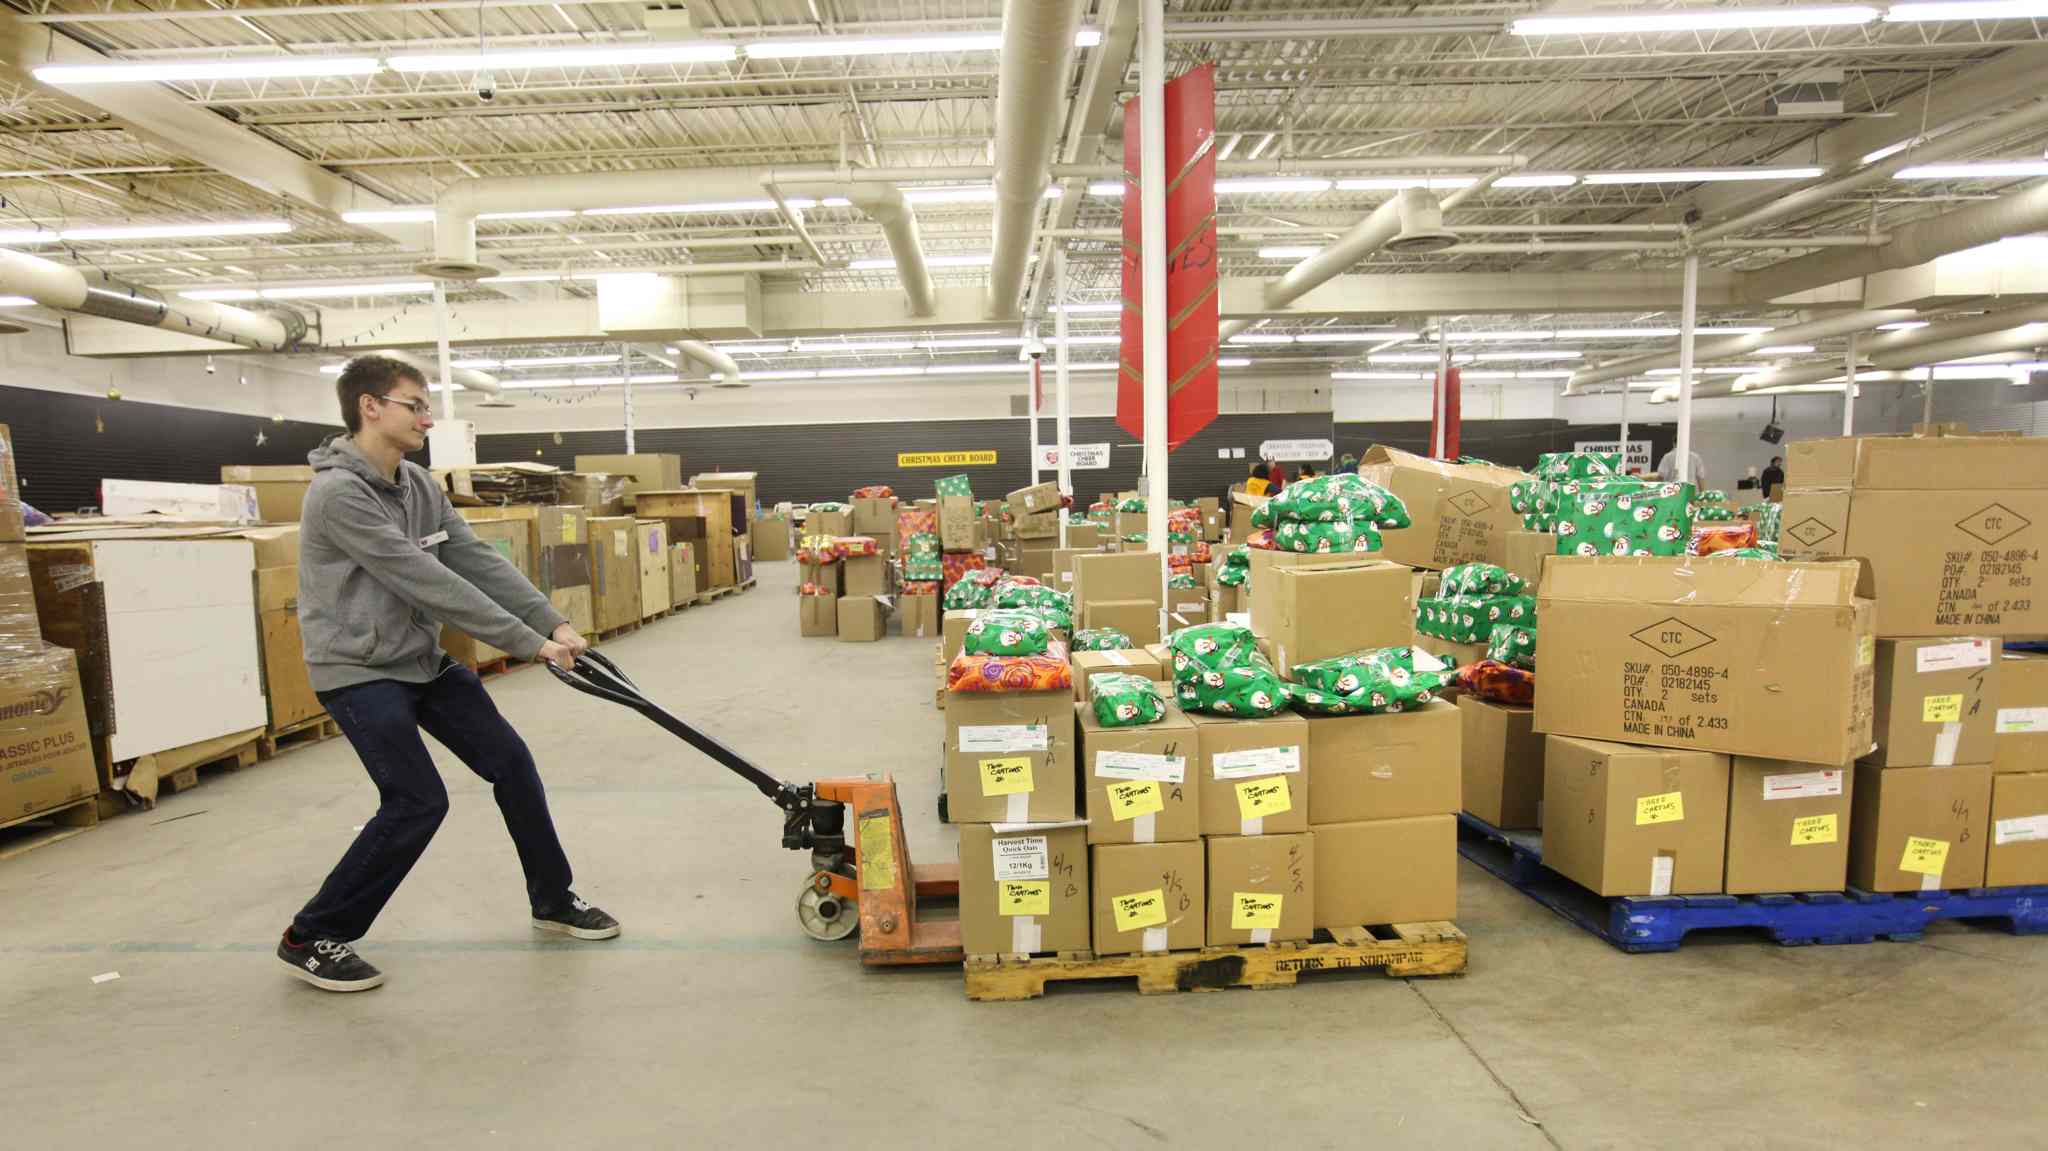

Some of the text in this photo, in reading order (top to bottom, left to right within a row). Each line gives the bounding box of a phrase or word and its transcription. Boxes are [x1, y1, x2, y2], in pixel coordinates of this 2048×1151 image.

[1584, 444, 1643, 453] CHRISTAS
[901, 454, 941, 464] CHRISTMAS
[969, 453, 994, 462] BOARD
[1984, 518, 2002, 530] CTC
[1977, 576, 1985, 588] 2
[1940, 588, 1976, 601] CANADA
[1936, 614, 1960, 624] MADE
[1661, 632, 1682, 644] CTC
[1661, 664, 1728, 680] 050-4896-4
[1661, 676, 1710, 690] 02182145
[1662, 689, 1668, 700] 2
[1691, 691, 1718, 704] sets
[1624, 698, 1666, 712] CANADA
[1679, 714, 1691, 726] of
[1624, 722, 1696, 738] MADE IN CHINA
[44, 731, 75, 751] PLUS
[1170, 787, 1183, 802] A
[1275, 956, 1324, 972] RETURN
